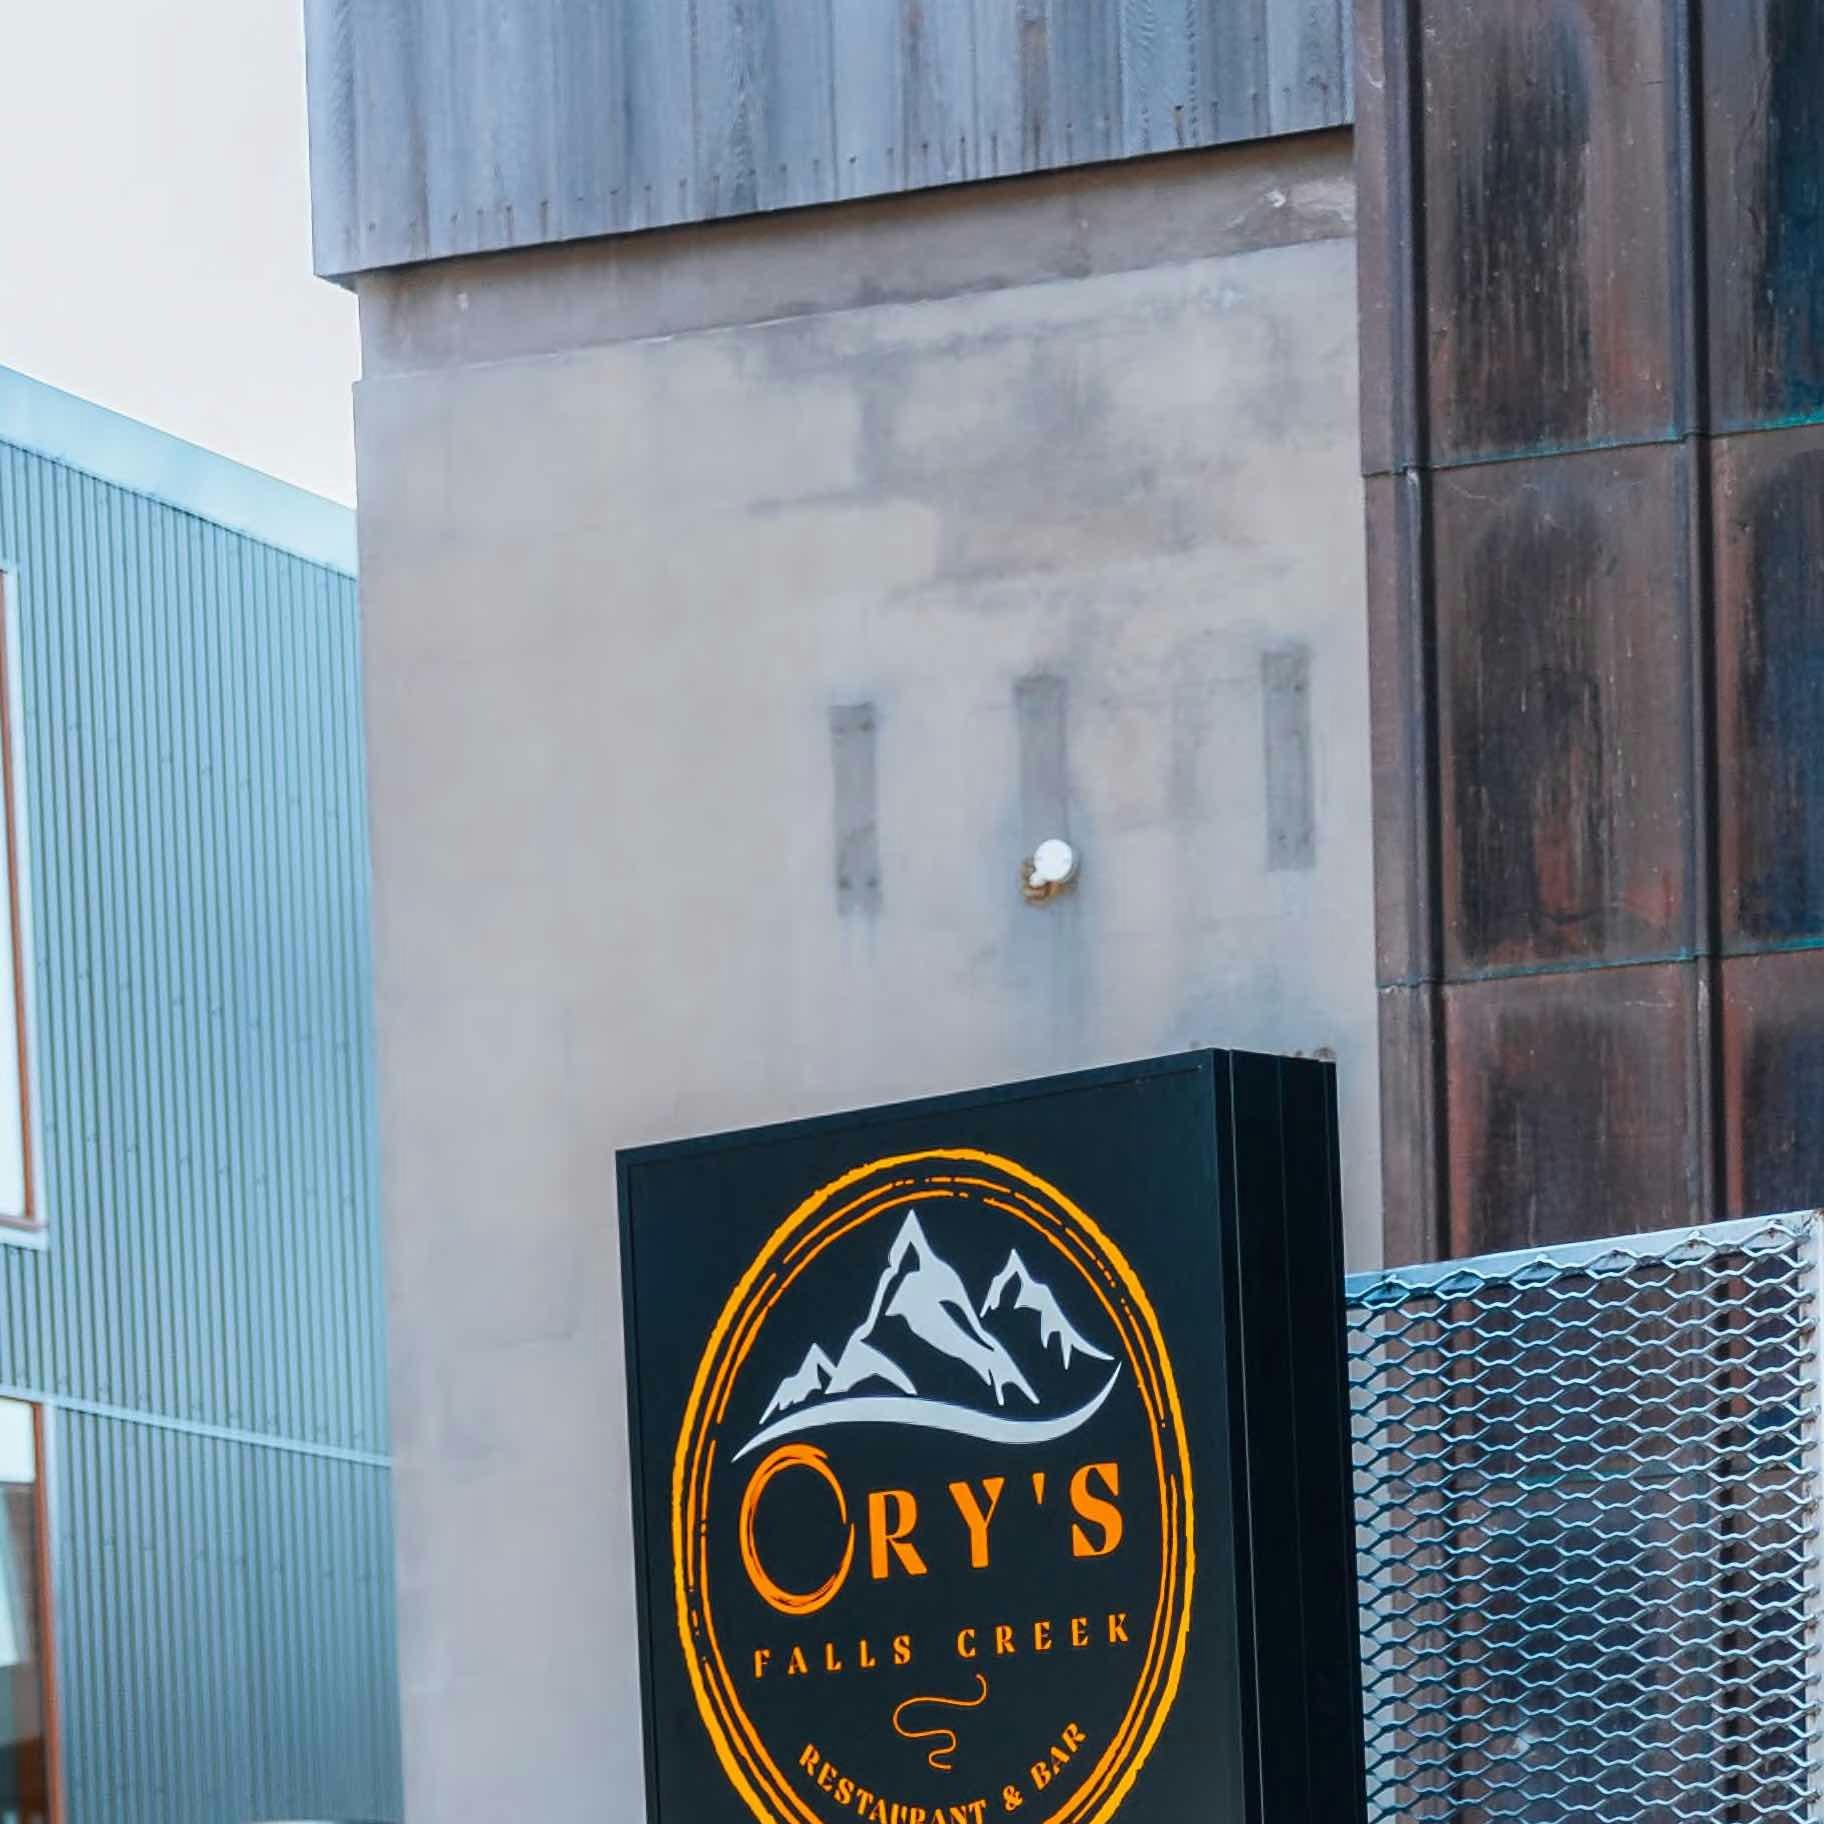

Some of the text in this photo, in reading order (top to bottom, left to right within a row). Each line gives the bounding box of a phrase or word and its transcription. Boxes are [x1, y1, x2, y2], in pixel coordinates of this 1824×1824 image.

[739, 1443, 1123, 1615] ORY'S
[753, 1612, 1130, 1679] FALLS CREEK
[1001, 1784, 1024, 1812] &
[1030, 1722, 1087, 1793] BAR
